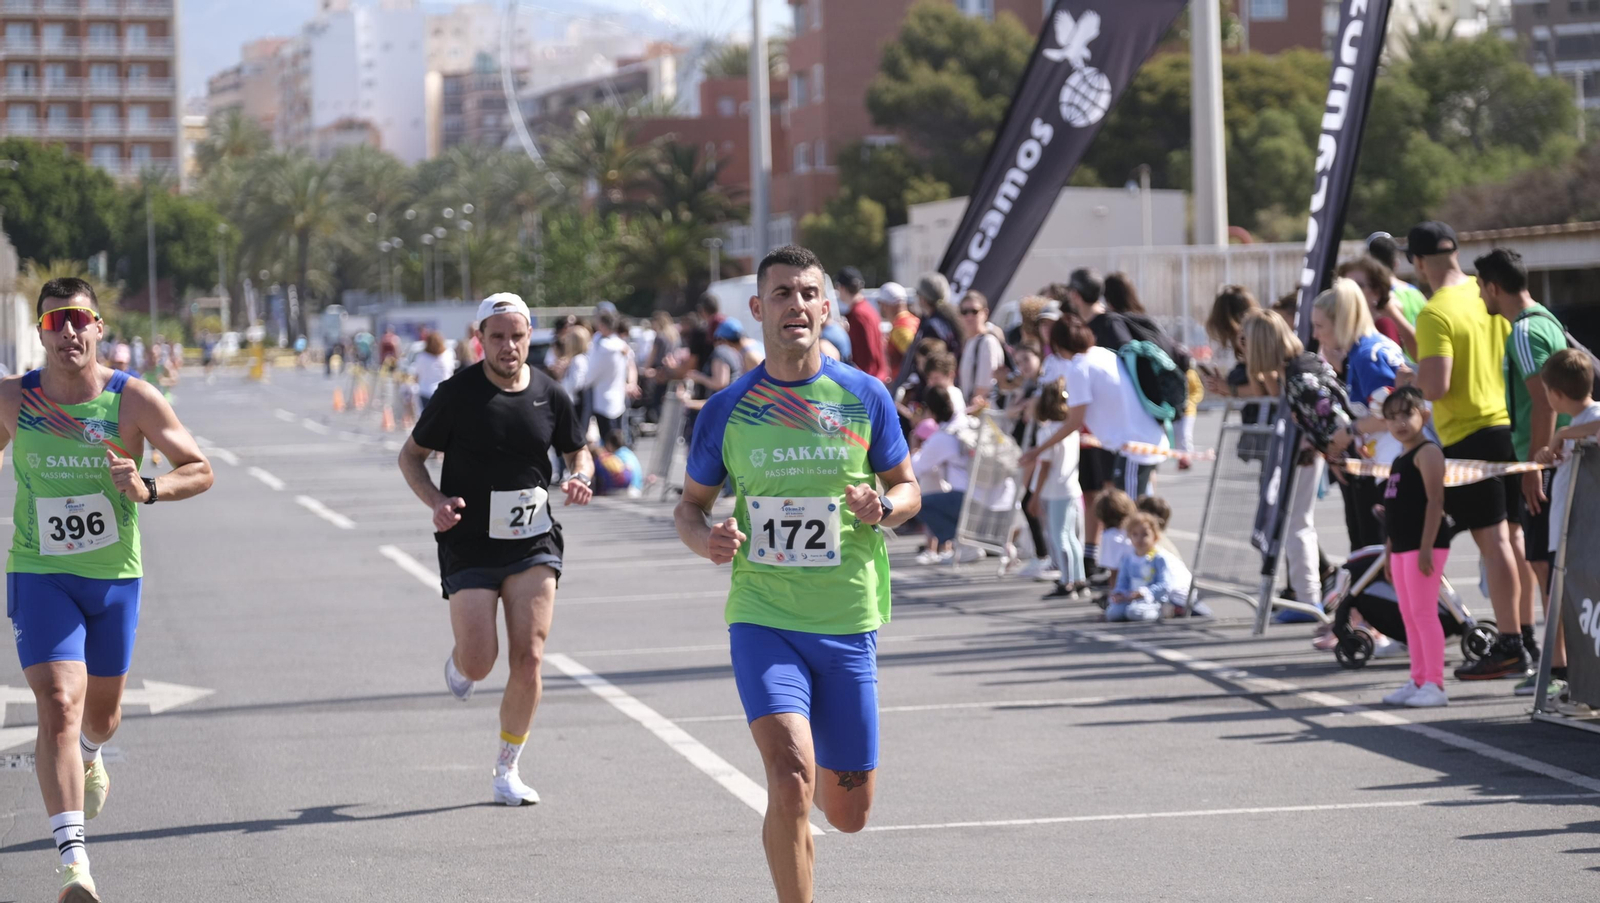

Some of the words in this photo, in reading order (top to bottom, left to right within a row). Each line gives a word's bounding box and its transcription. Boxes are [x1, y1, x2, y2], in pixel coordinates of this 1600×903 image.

[46, 455, 110, 468] SAKATA
[772, 446, 849, 463] SAKATA
[84, 471, 103, 480] Seed
[765, 466, 805, 478] PASSION
[806, 467, 815, 475] in
[816, 466, 838, 475] Seed
[509, 503, 537, 528] 27
[48, 511, 105, 542] 396
[763, 518, 827, 550] 172
